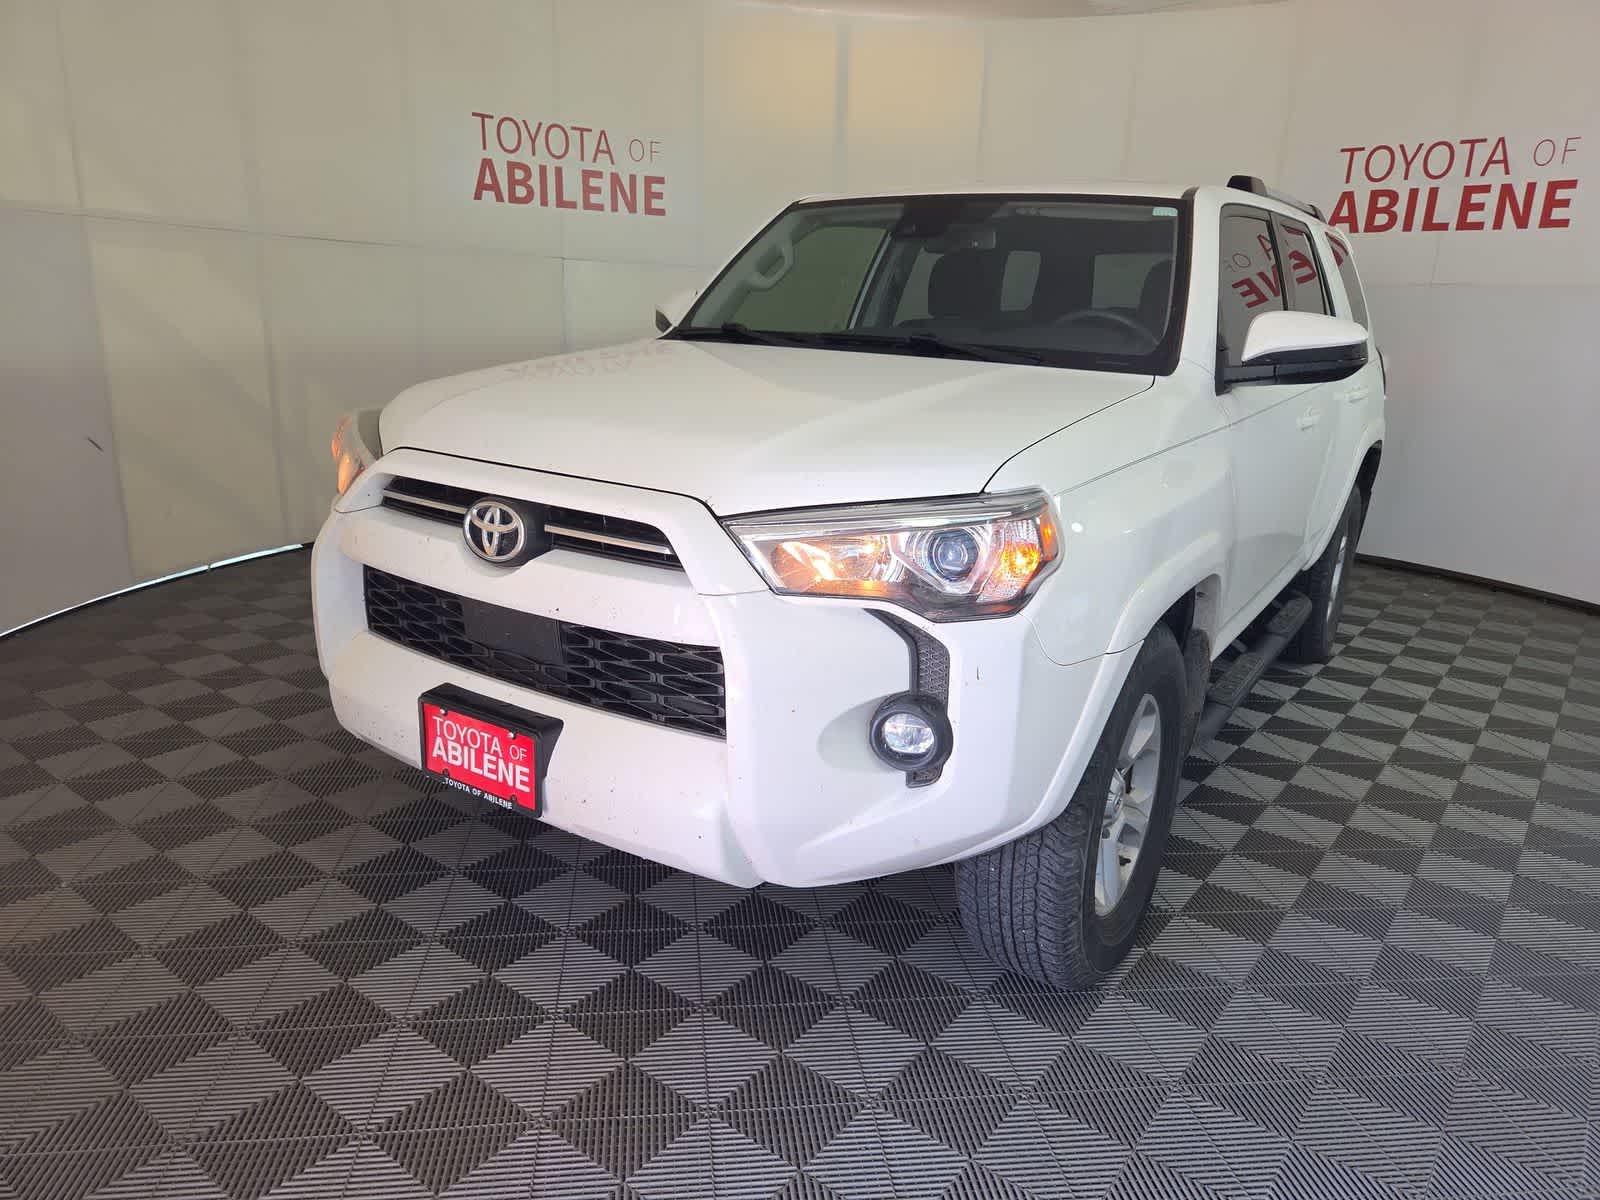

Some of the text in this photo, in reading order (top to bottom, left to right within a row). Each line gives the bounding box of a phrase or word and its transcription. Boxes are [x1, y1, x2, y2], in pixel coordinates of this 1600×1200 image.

[472, 112, 663, 165] TOYOTA OF
[1340, 137, 1582, 184] TOYOTA OF
[473, 158, 666, 216] ABILENE
[1327, 179, 1579, 234] ABILENE
[432, 716, 527, 761] TOYOTA OF
[432, 737, 530, 792] ABILENE
[445, 777, 513, 810] TOYOTA OF ABILENE
